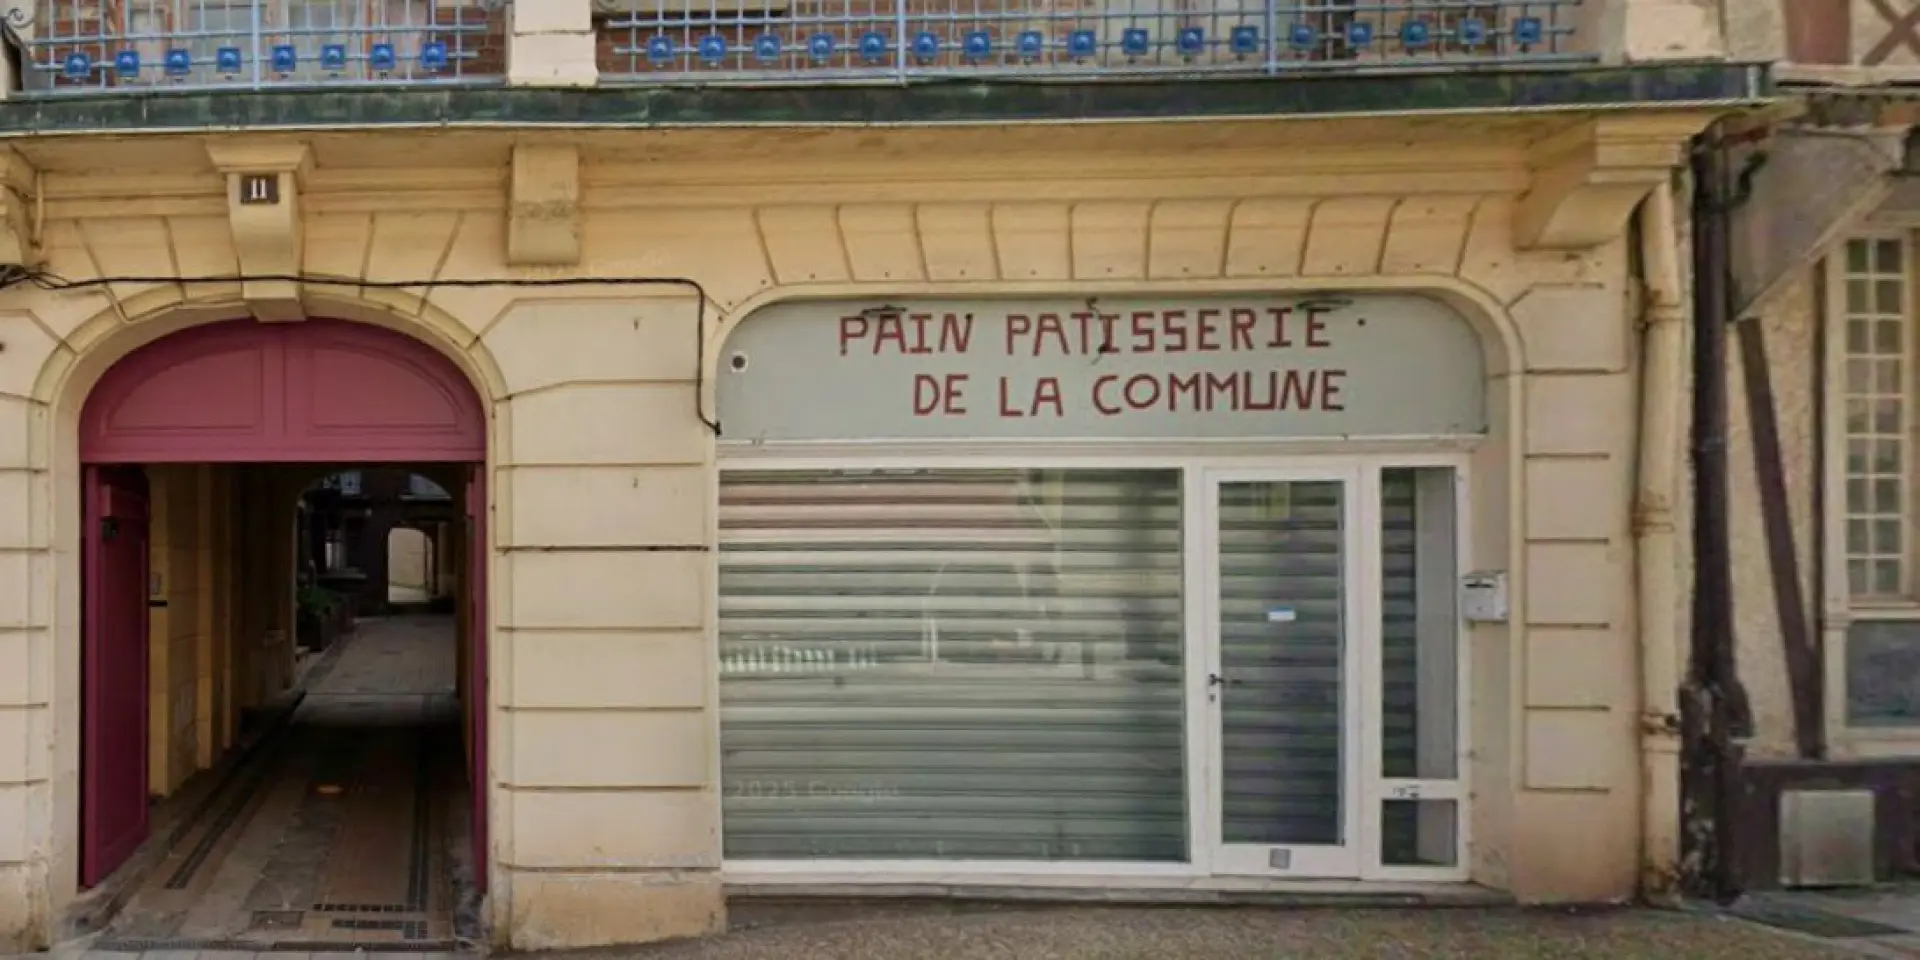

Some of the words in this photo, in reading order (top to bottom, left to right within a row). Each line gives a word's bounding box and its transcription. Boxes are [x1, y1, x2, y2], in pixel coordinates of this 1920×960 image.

[251, 177, 267, 200] 11
[840, 312, 973, 356] PAIN
[1006, 307, 1331, 356] PATISSERIE
[913, 374, 969, 416] DE
[999, 376, 1063, 417] LA
[1093, 369, 1347, 415] COMMUNE
